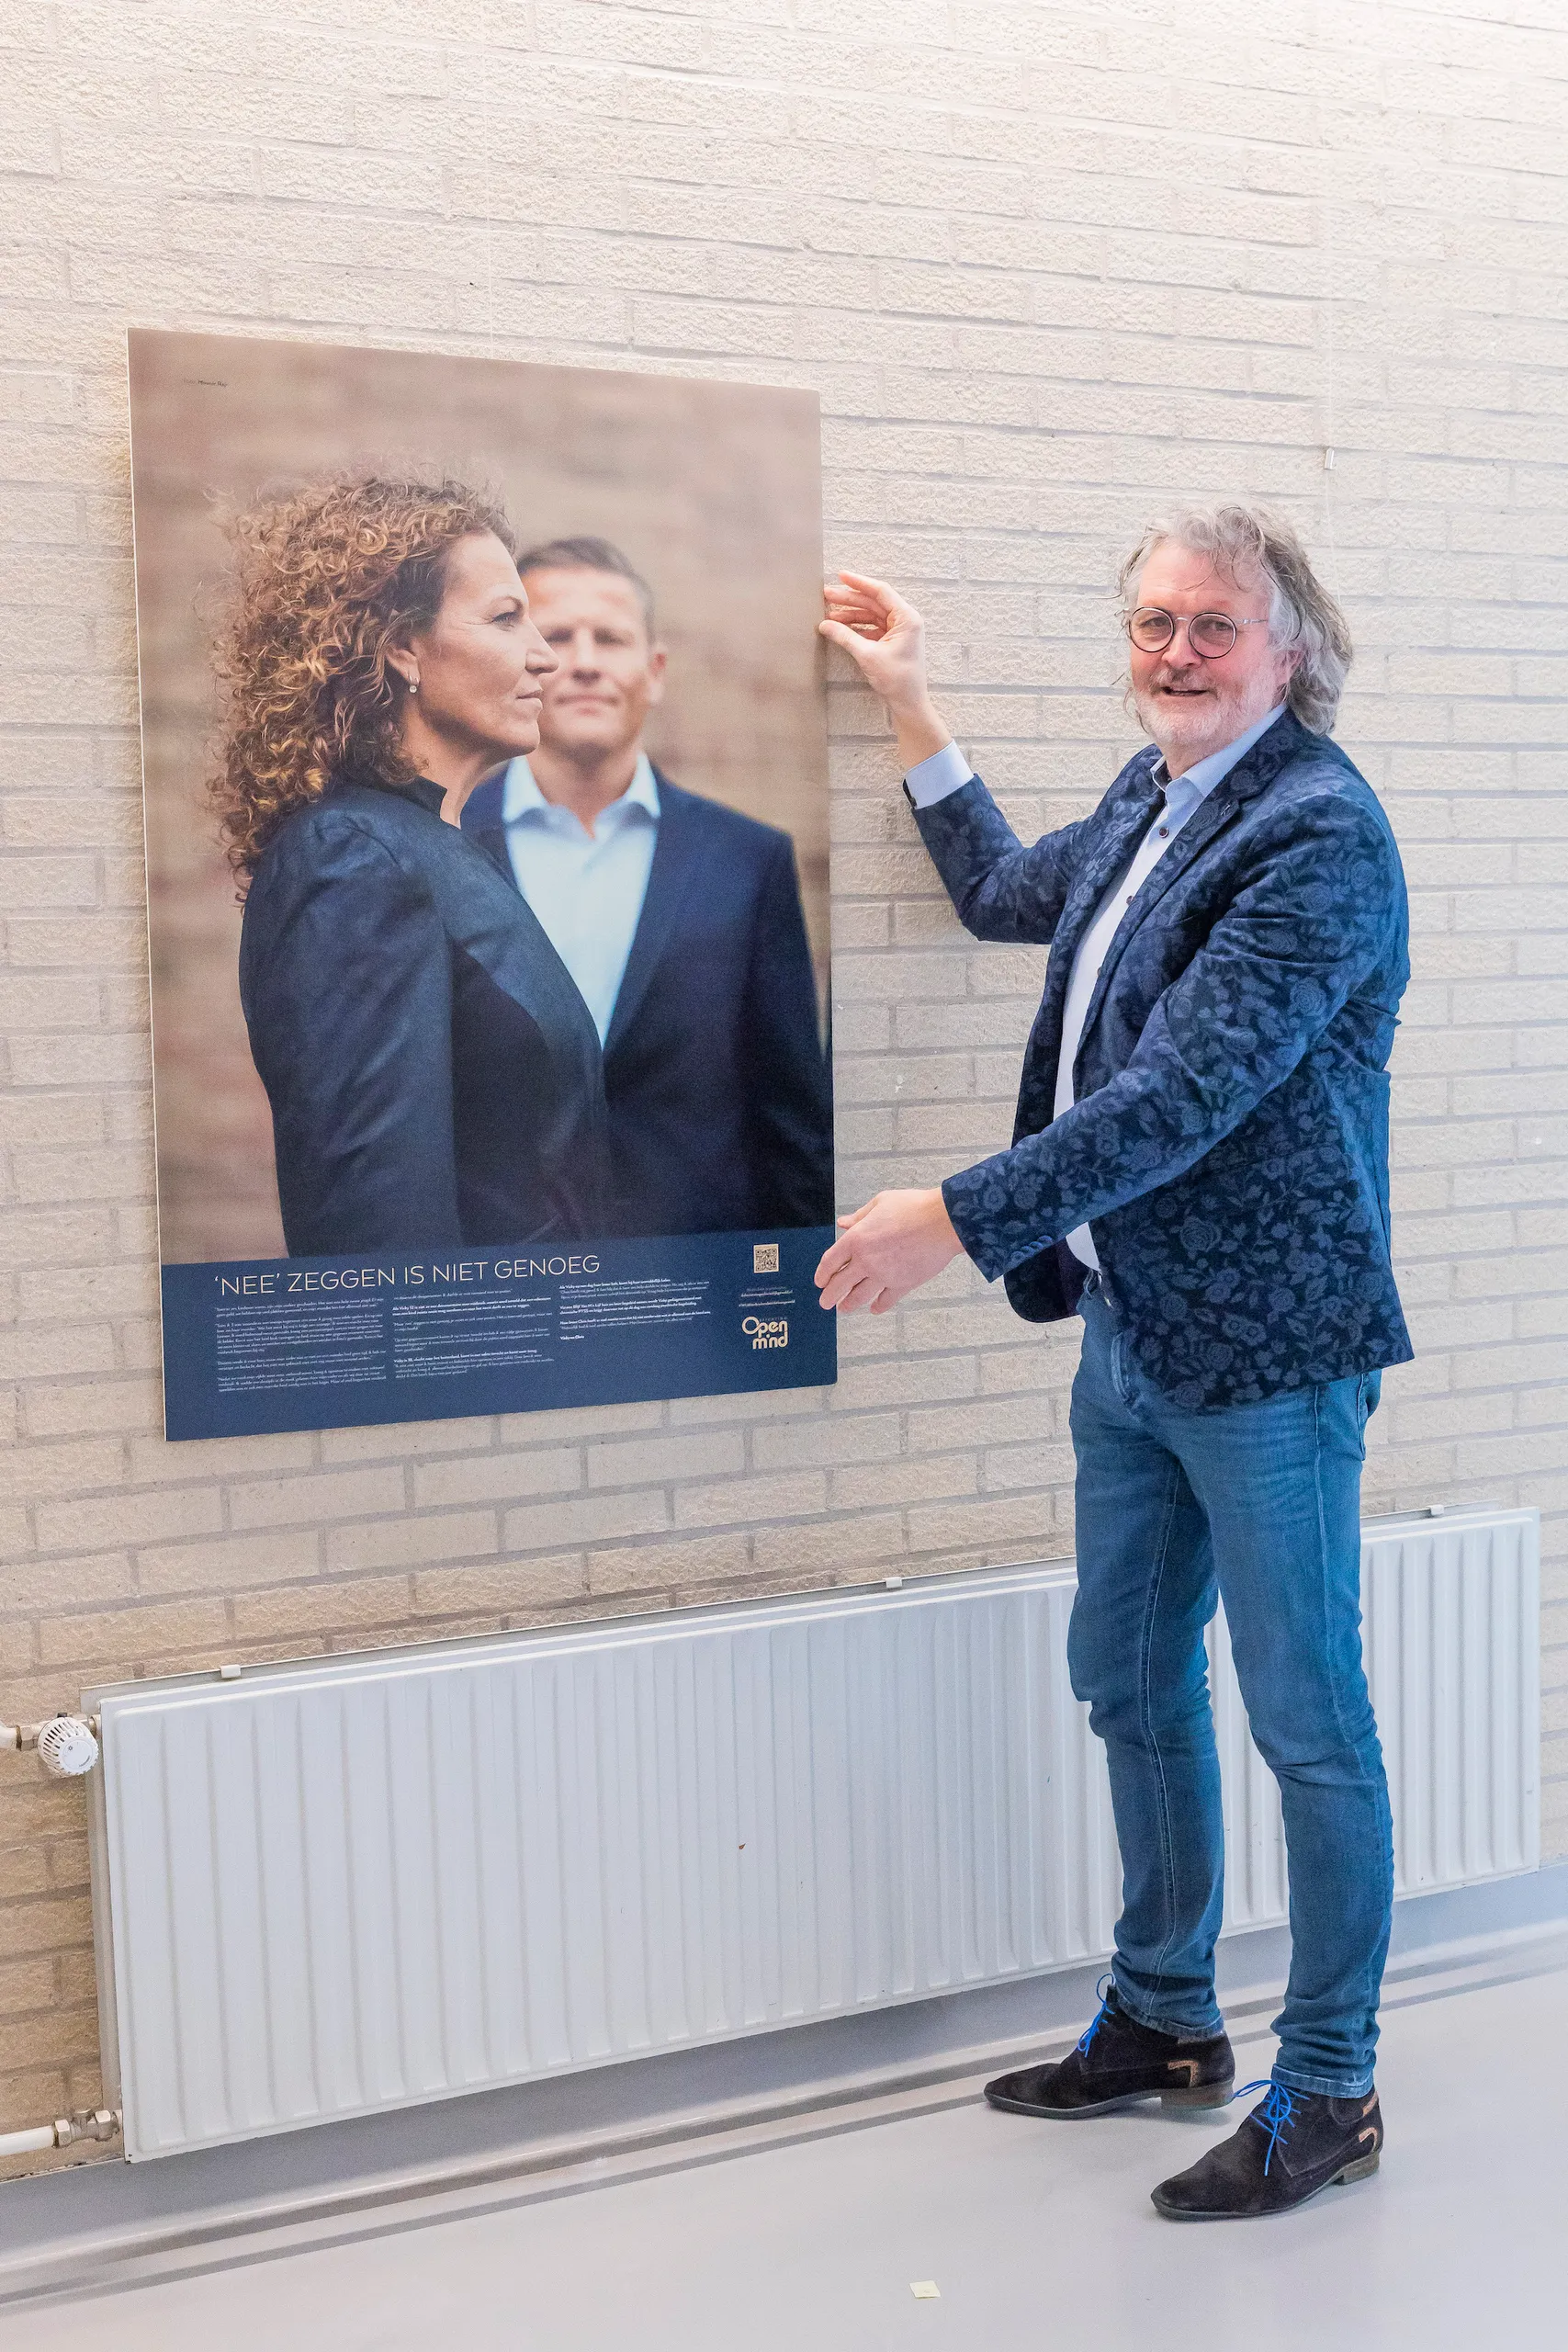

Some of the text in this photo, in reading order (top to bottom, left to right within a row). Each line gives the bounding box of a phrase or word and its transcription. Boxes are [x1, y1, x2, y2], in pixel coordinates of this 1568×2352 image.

[214, 1255, 600, 1296] ‘NEE’ ZEGGEN IS NIET GENOEG
[741, 1316, 788, 1338] Open
